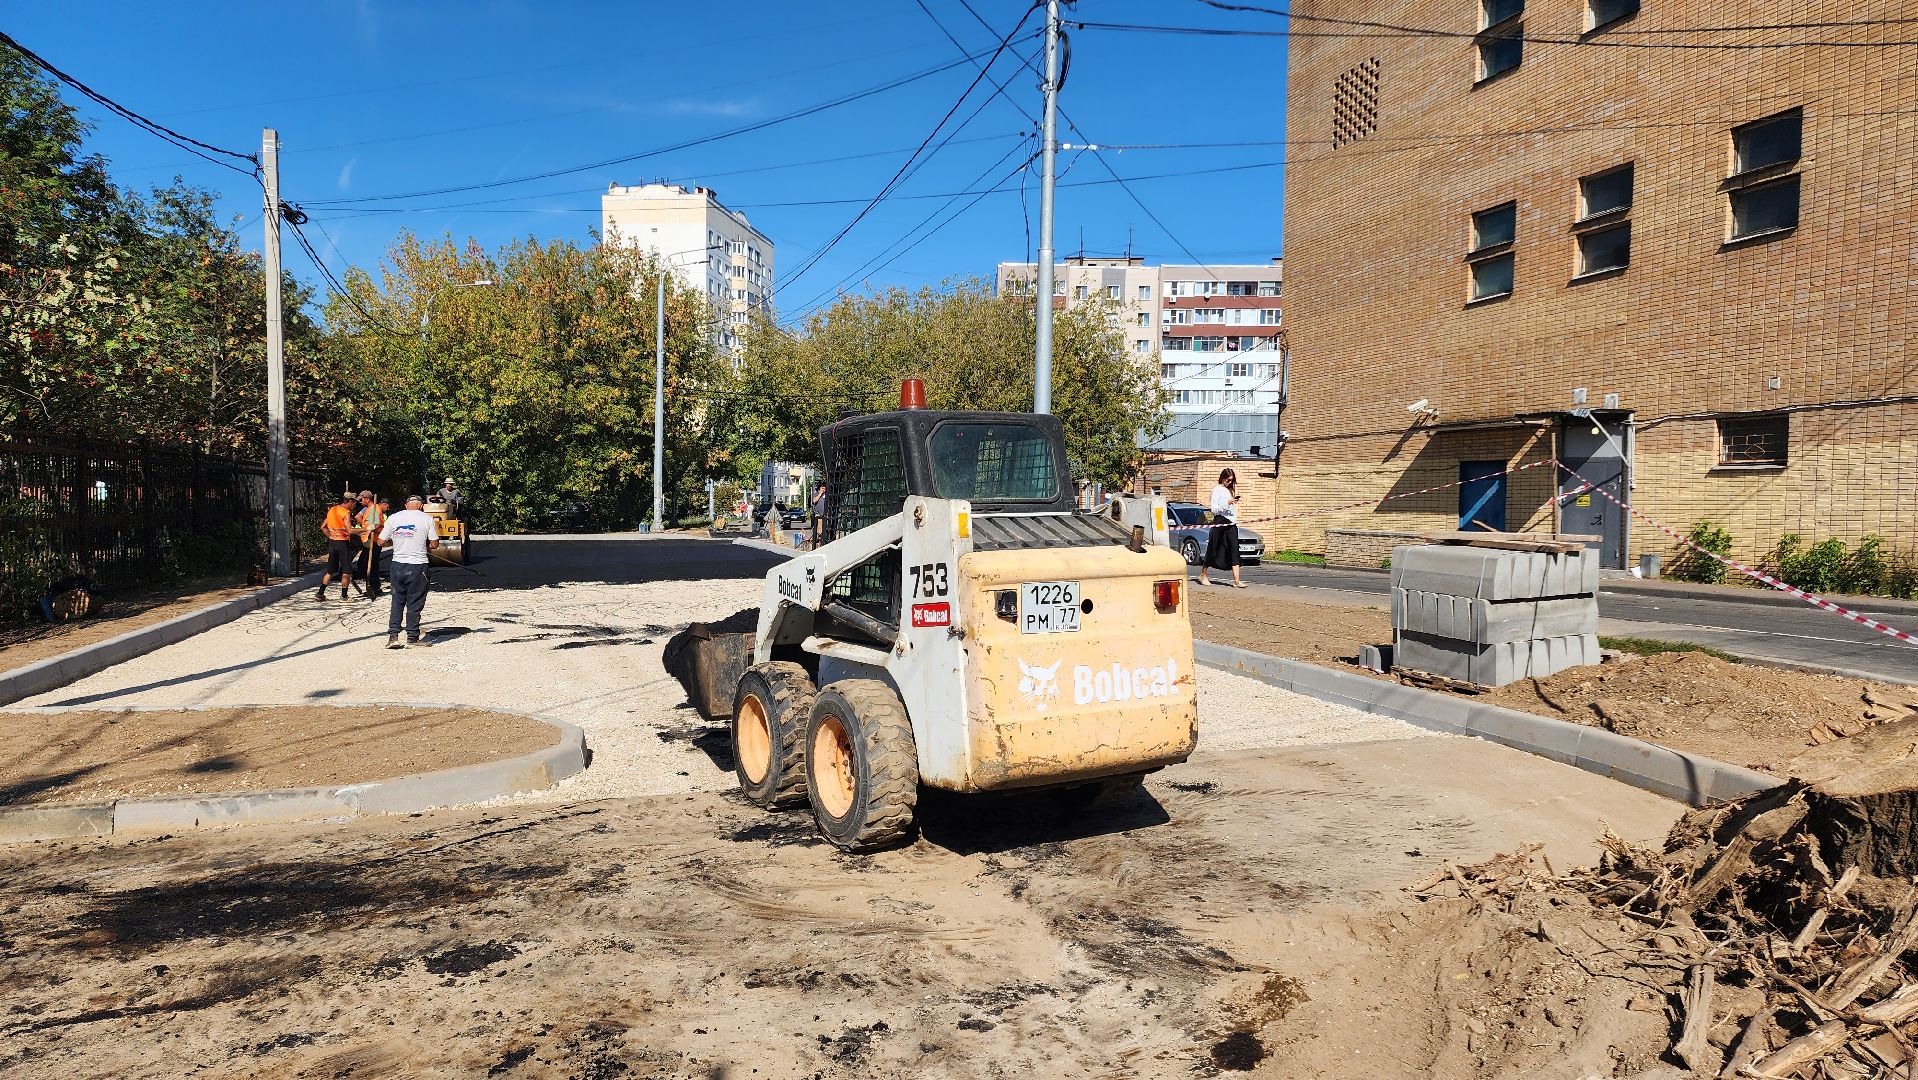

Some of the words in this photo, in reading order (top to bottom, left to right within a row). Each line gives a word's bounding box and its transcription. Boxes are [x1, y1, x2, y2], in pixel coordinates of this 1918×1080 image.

[779, 575, 801, 602] Bobcat
[910, 563, 948, 598] 753
[1030, 585, 1072, 605] 1226
[924, 609, 948, 623] Bobcat
[1027, 614, 1048, 630] PM
[1060, 608, 1075, 623] 77
[1073, 658, 1180, 704] Bobcat
